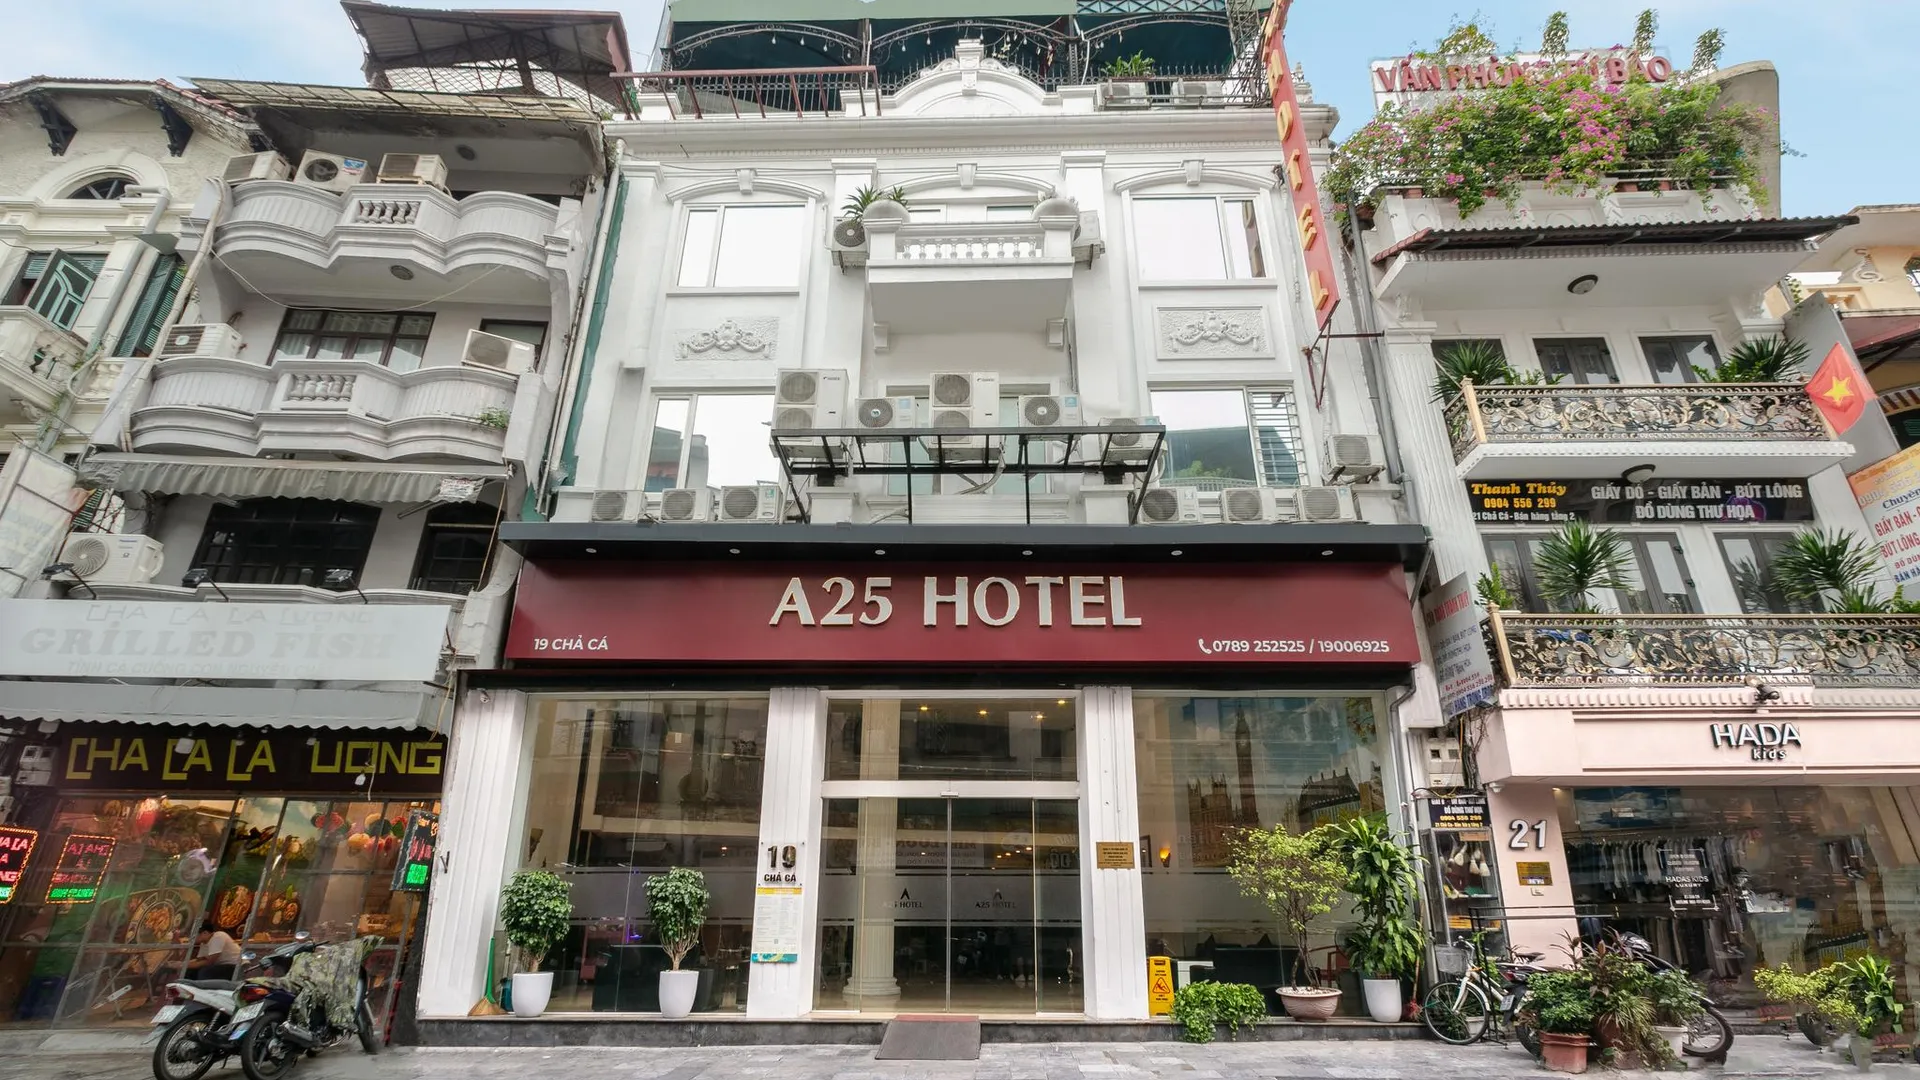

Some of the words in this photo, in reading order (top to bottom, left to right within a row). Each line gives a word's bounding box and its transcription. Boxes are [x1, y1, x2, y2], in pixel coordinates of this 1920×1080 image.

[1471, 483, 1521, 495] Thanh
[1526, 481, 1567, 496] Thủy
[1591, 483, 1621, 499] GIẤY
[1658, 482, 1687, 499] GIẤY
[1691, 481, 1721, 499] BẢN
[1735, 483, 1764, 499] BÚT
[1766, 483, 1803, 499] LÔNG
[1484, 497, 1509, 509] 0904
[1513, 497, 1533, 509] 556
[1537, 497, 1556, 509] 299
[1657, 503, 1695, 519] DÙNG
[769, 577, 893, 626] A25
[923, 576, 1142, 627] HOTEL
[534, 637, 548, 651] 19
[551, 634, 584, 651] CHẢ
[587, 635, 609, 651] CÁ
[1212, 639, 1250, 653] 0789
[1254, 639, 1305, 653] 252525
[1318, 639, 1390, 654] 19006925
[1710, 723, 1801, 749] HADA
[65, 738, 149, 781] CHA
[1752, 747, 1786, 761] kids
[1509, 818, 1547, 851] 21
[767, 845, 797, 869] 19
[763, 870, 782, 882] CHẢ
[784, 871, 797, 882] CÁ
